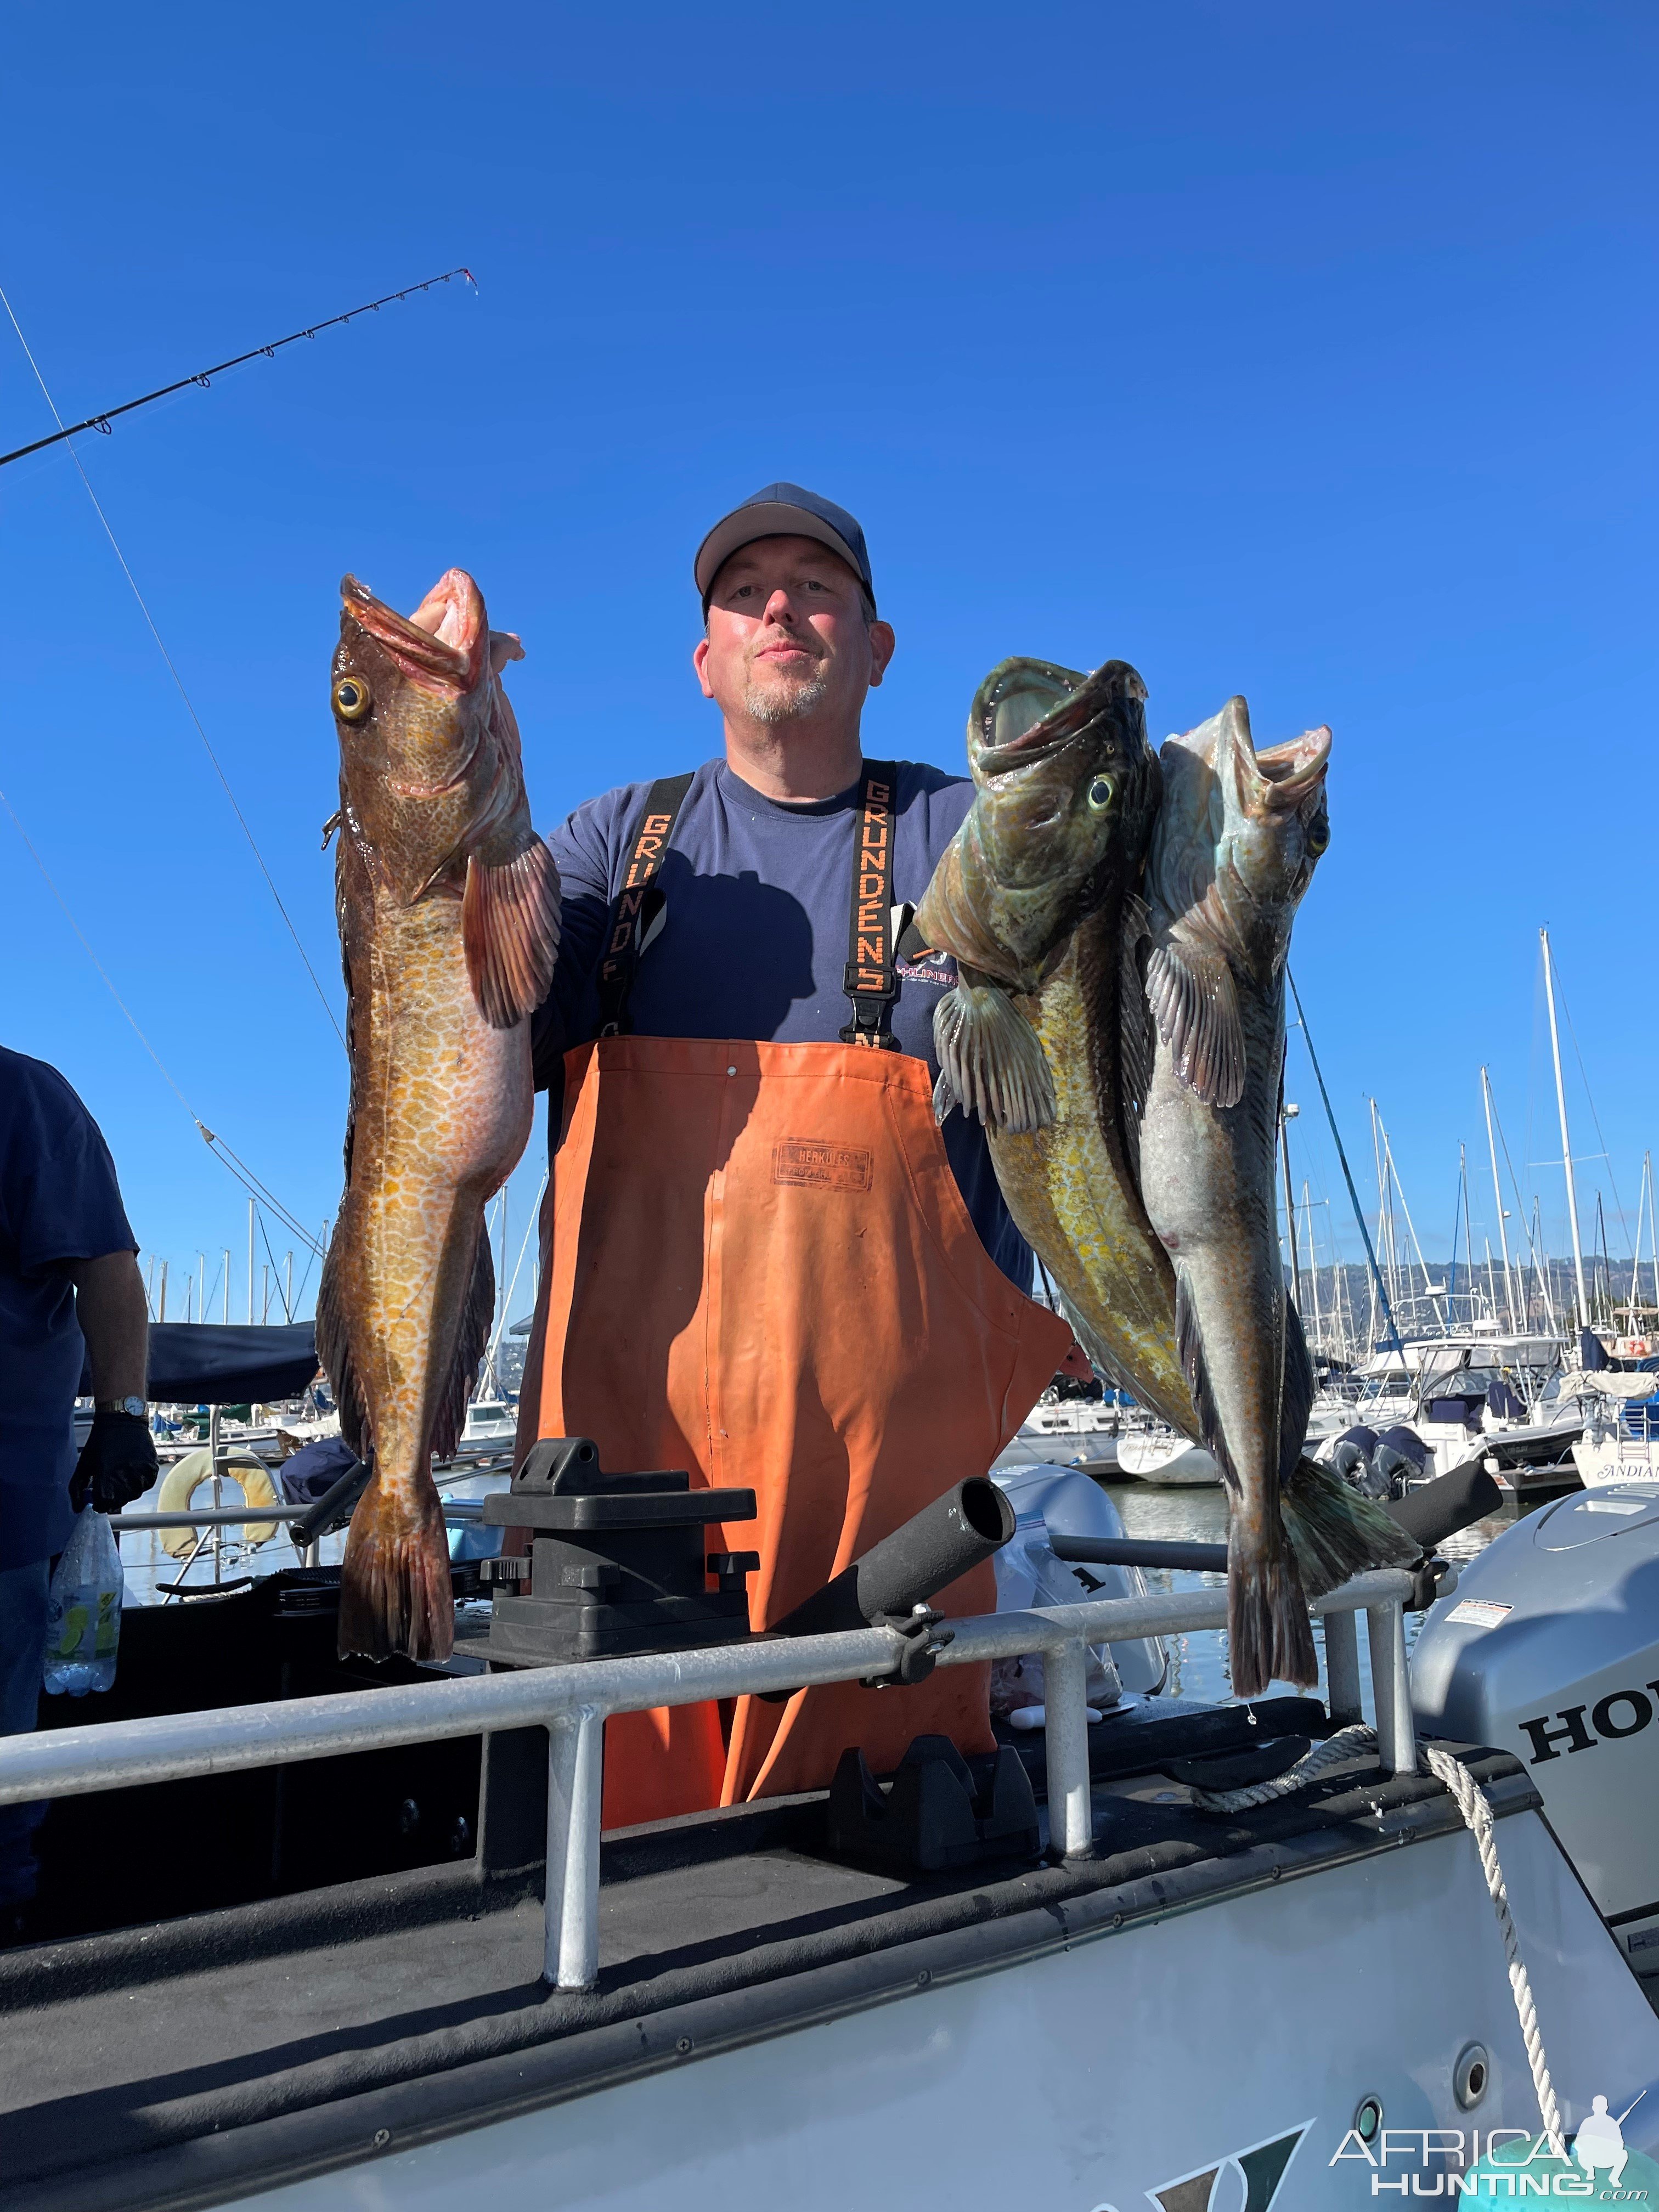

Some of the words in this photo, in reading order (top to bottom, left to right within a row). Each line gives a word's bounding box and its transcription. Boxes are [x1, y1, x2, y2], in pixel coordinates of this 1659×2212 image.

[857, 780, 889, 991] GRUNDENS
[799, 1150, 850, 1166] HERKULES
[1518, 1680, 1659, 1765] HO
